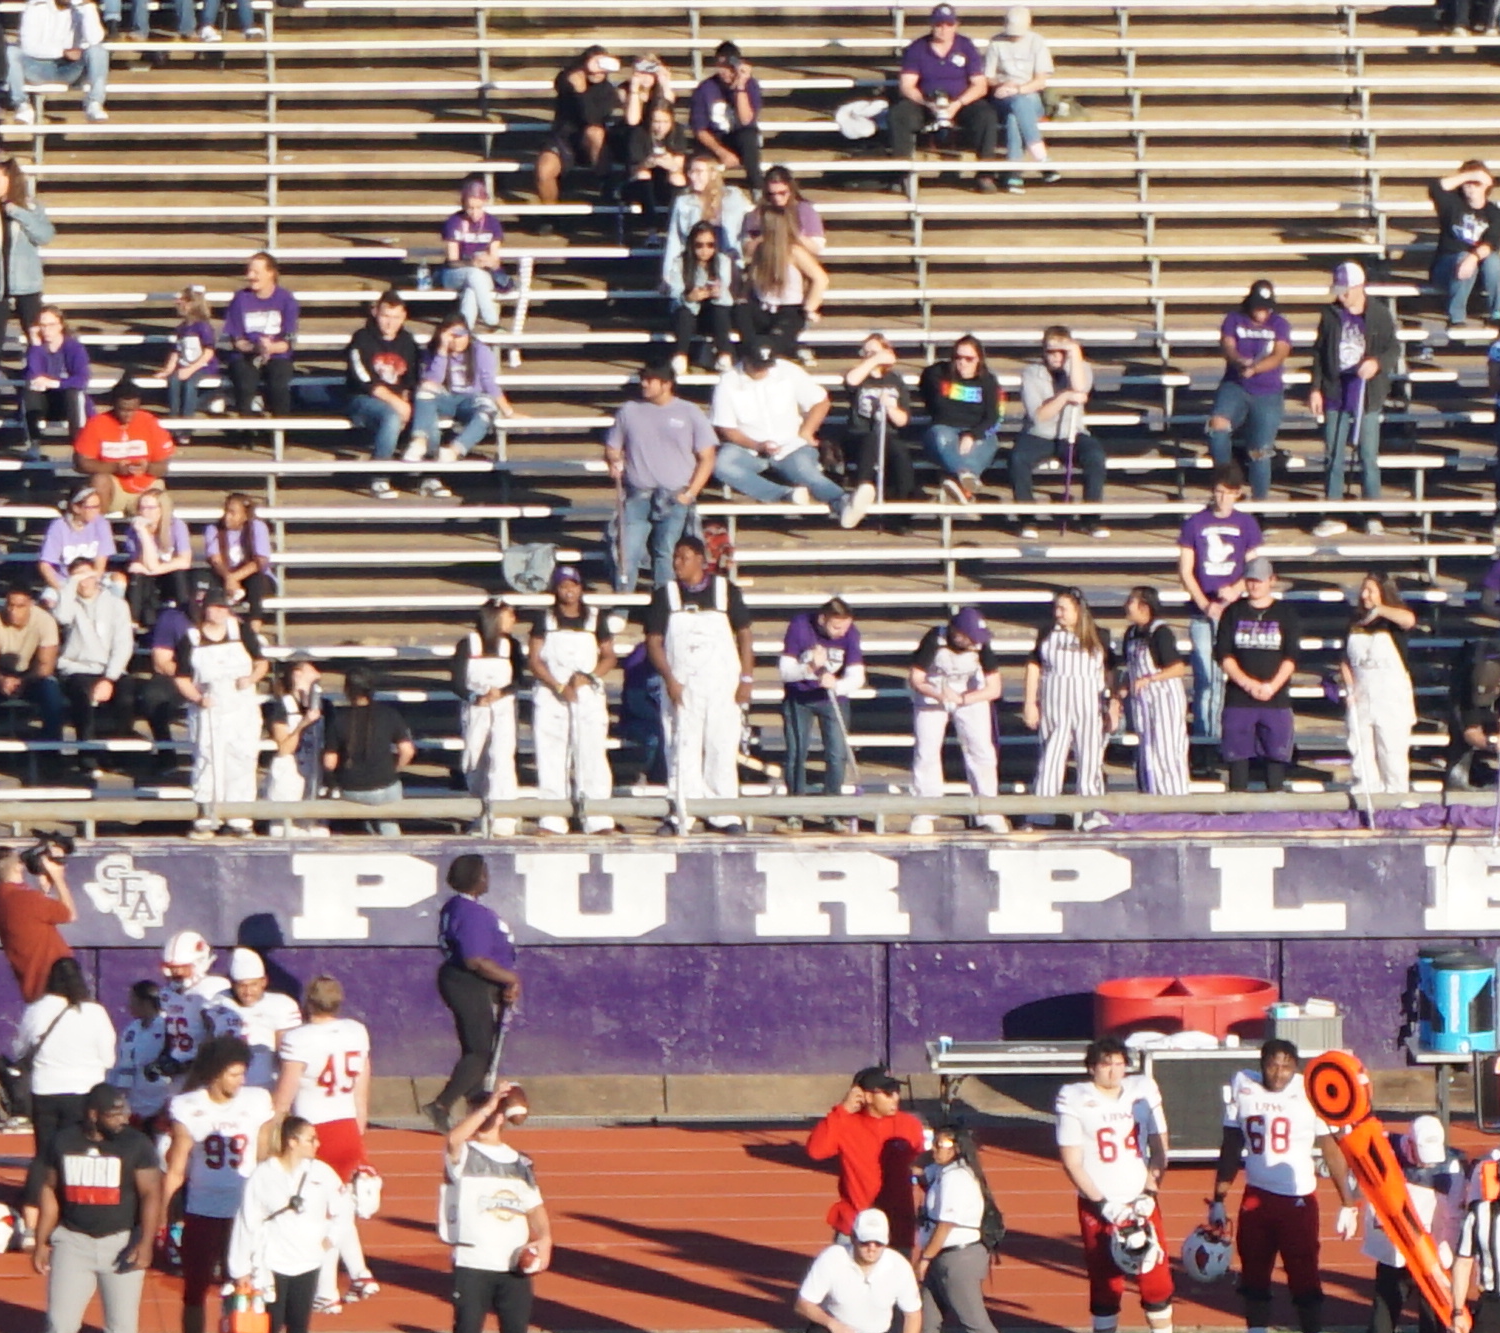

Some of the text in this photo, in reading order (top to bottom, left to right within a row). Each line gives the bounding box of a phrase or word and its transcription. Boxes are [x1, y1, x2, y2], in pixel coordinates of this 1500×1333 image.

[101, 862, 161, 922] SFA
[317, 1052, 361, 1096] 45
[204, 1133, 248, 1170] 99
[1096, 1125, 1142, 1163] 64
[1246, 1115, 1291, 1154] 68
[62, 1155, 121, 1187] WORD
